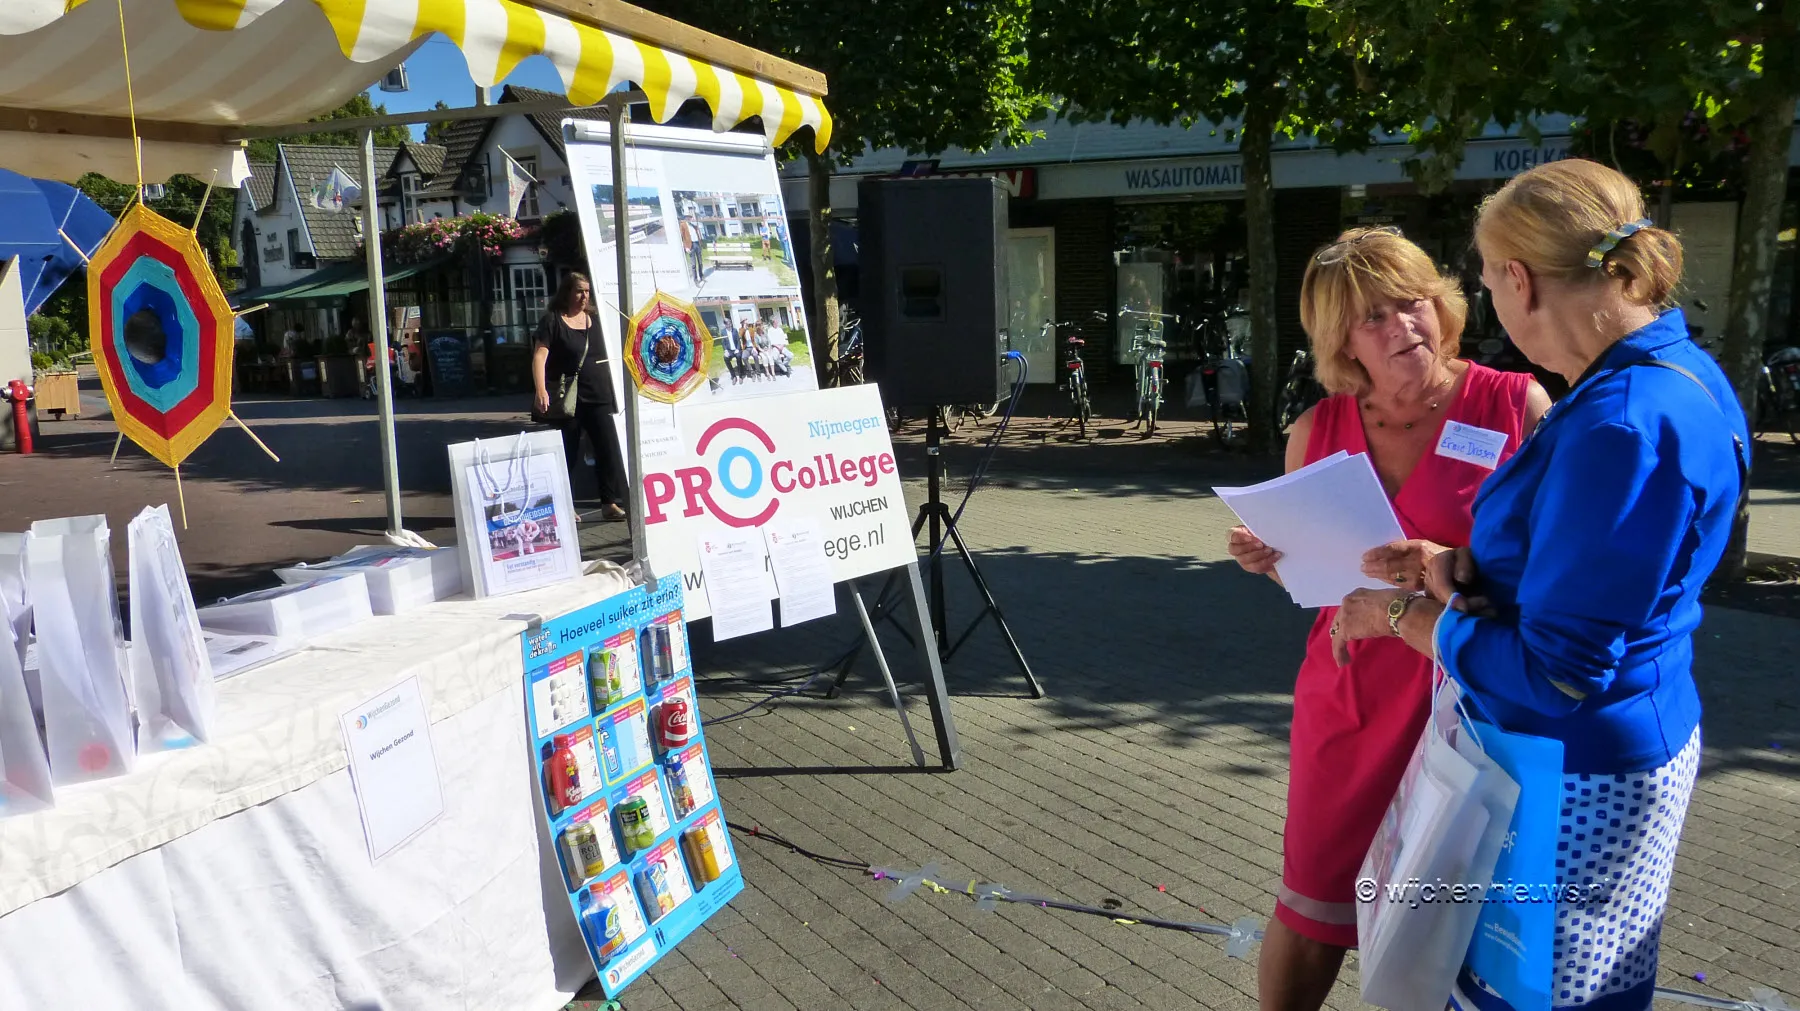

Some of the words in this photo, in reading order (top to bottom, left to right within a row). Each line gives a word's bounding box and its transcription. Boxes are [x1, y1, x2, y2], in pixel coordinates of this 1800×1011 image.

[808, 416, 880, 439] Nijmegen
[770, 452, 895, 494] College
[830, 496, 889, 520] WIJCHEN
[560, 616, 606, 644] Hoeveel
[608, 603, 639, 626] suiker
[641, 596, 654, 612] zit
[656, 584, 679, 606] erin?
[528, 630, 551, 646] water
[369, 743, 393, 761] Wijchen
[393, 729, 414, 747] Gezond
